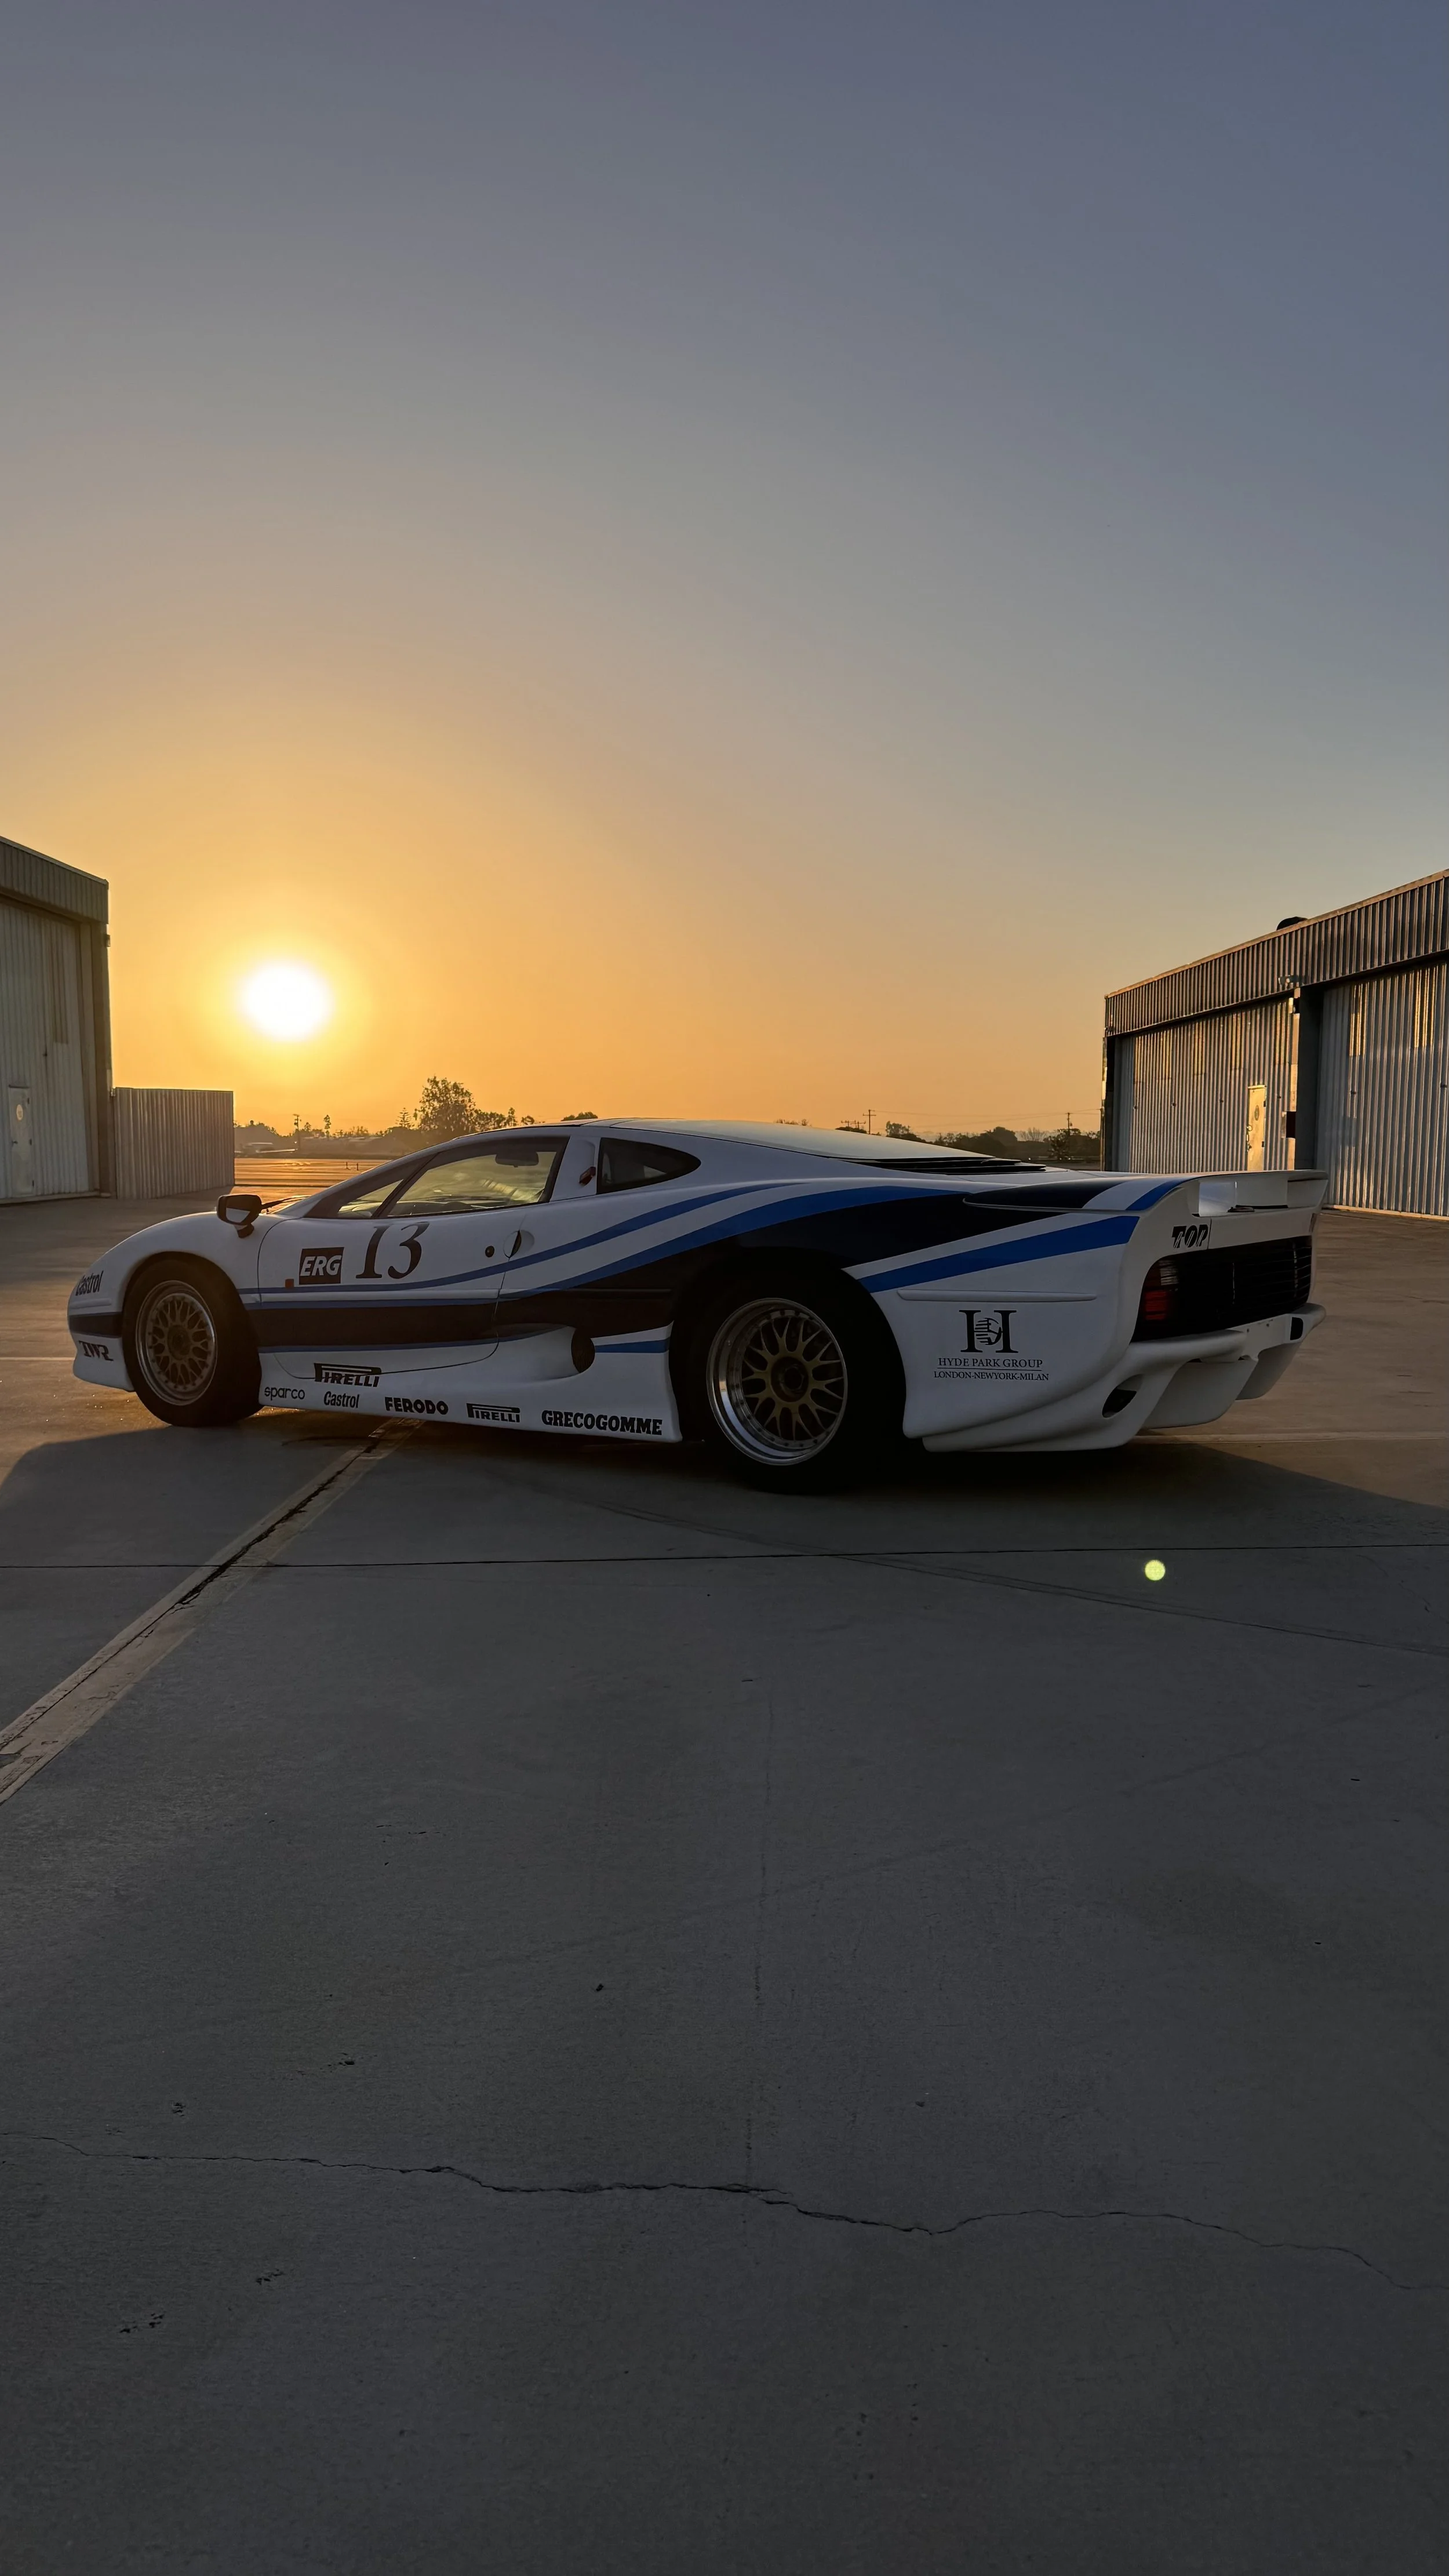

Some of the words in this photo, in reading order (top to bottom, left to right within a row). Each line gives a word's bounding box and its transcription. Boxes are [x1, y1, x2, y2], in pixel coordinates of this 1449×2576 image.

[356, 1221, 430, 1279] 13
[300, 1255, 341, 1276] ERG
[75, 1270, 104, 1296] Castrol
[78, 1340, 114, 1362] TWR
[938, 1358, 969, 1367] HYDE
[972, 1358, 1001, 1367] PARK
[1002, 1359, 1043, 1368] GROUP
[314, 1363, 382, 1387] PIRELLI
[264, 1387, 305, 1400] sparco
[323, 1391, 360, 1408] Castrol
[385, 1396, 449, 1415] FERODO
[467, 1403, 520, 1422] PIRELLI
[541, 1410, 662, 1435] GRECOGOMME
